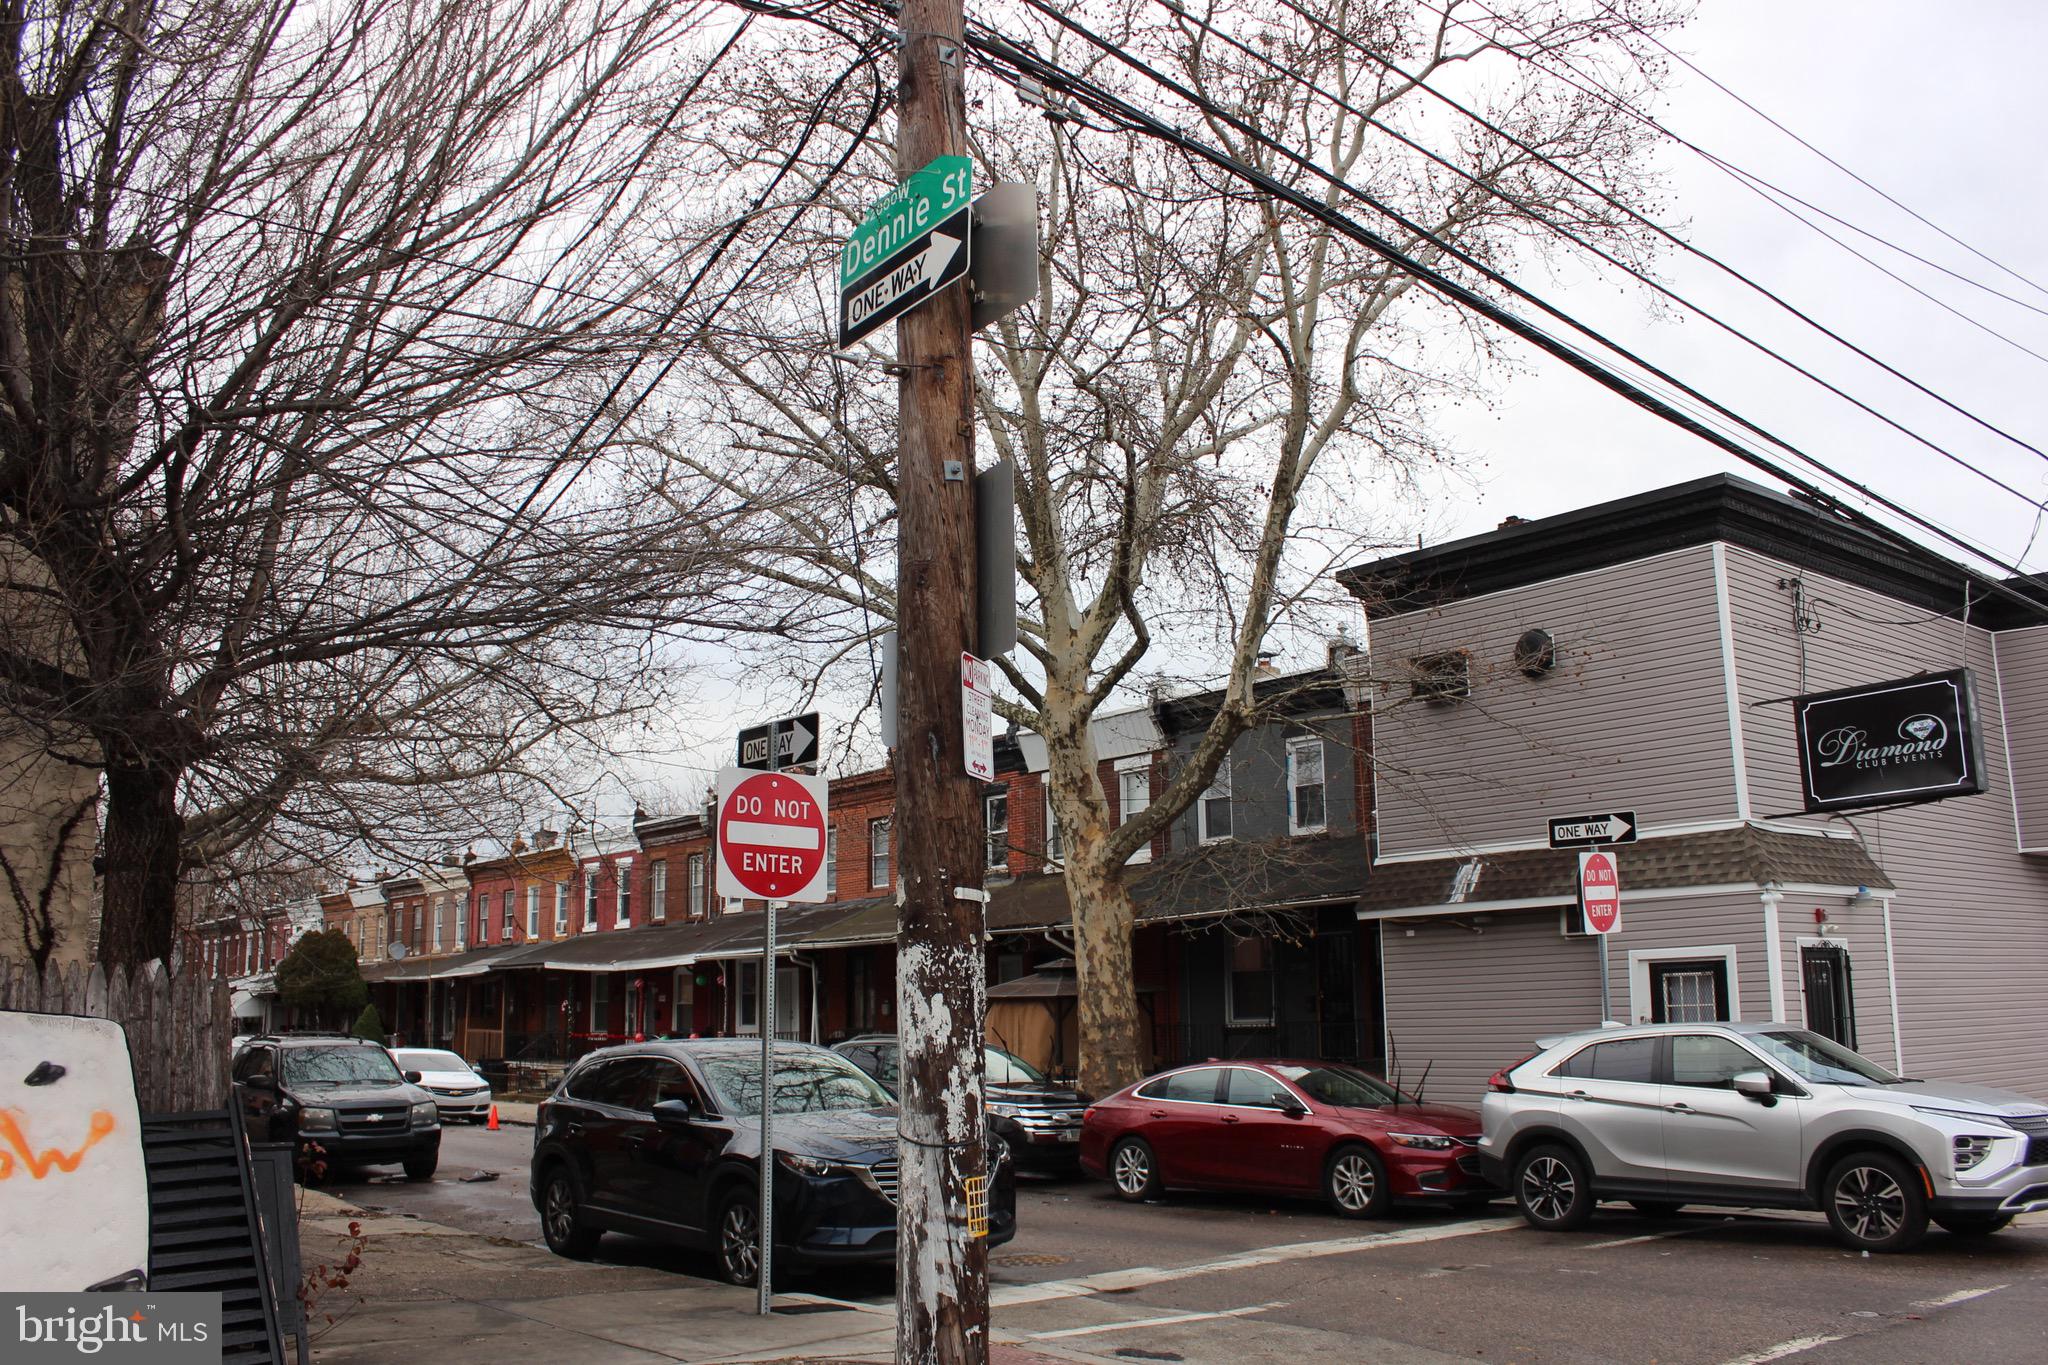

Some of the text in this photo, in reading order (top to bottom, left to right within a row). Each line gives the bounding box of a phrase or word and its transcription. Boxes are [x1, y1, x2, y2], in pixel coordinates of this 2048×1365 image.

[846, 168, 966, 277] Dennie St
[852, 254, 927, 322] ONE WAY
[963, 658, 973, 684] NO
[965, 716, 990, 738] MONDAY
[746, 734, 793, 761] ONE AY
[1818, 713, 1947, 768] Diamond
[1856, 750, 1943, 769] CLUB EVENTS
[736, 795, 810, 819] DO NOT
[1557, 823, 1609, 838] ONE WAY
[743, 852, 802, 875] ENTER
[1586, 870, 1612, 881] DO NOT
[1591, 904, 1613, 917] ENTER
